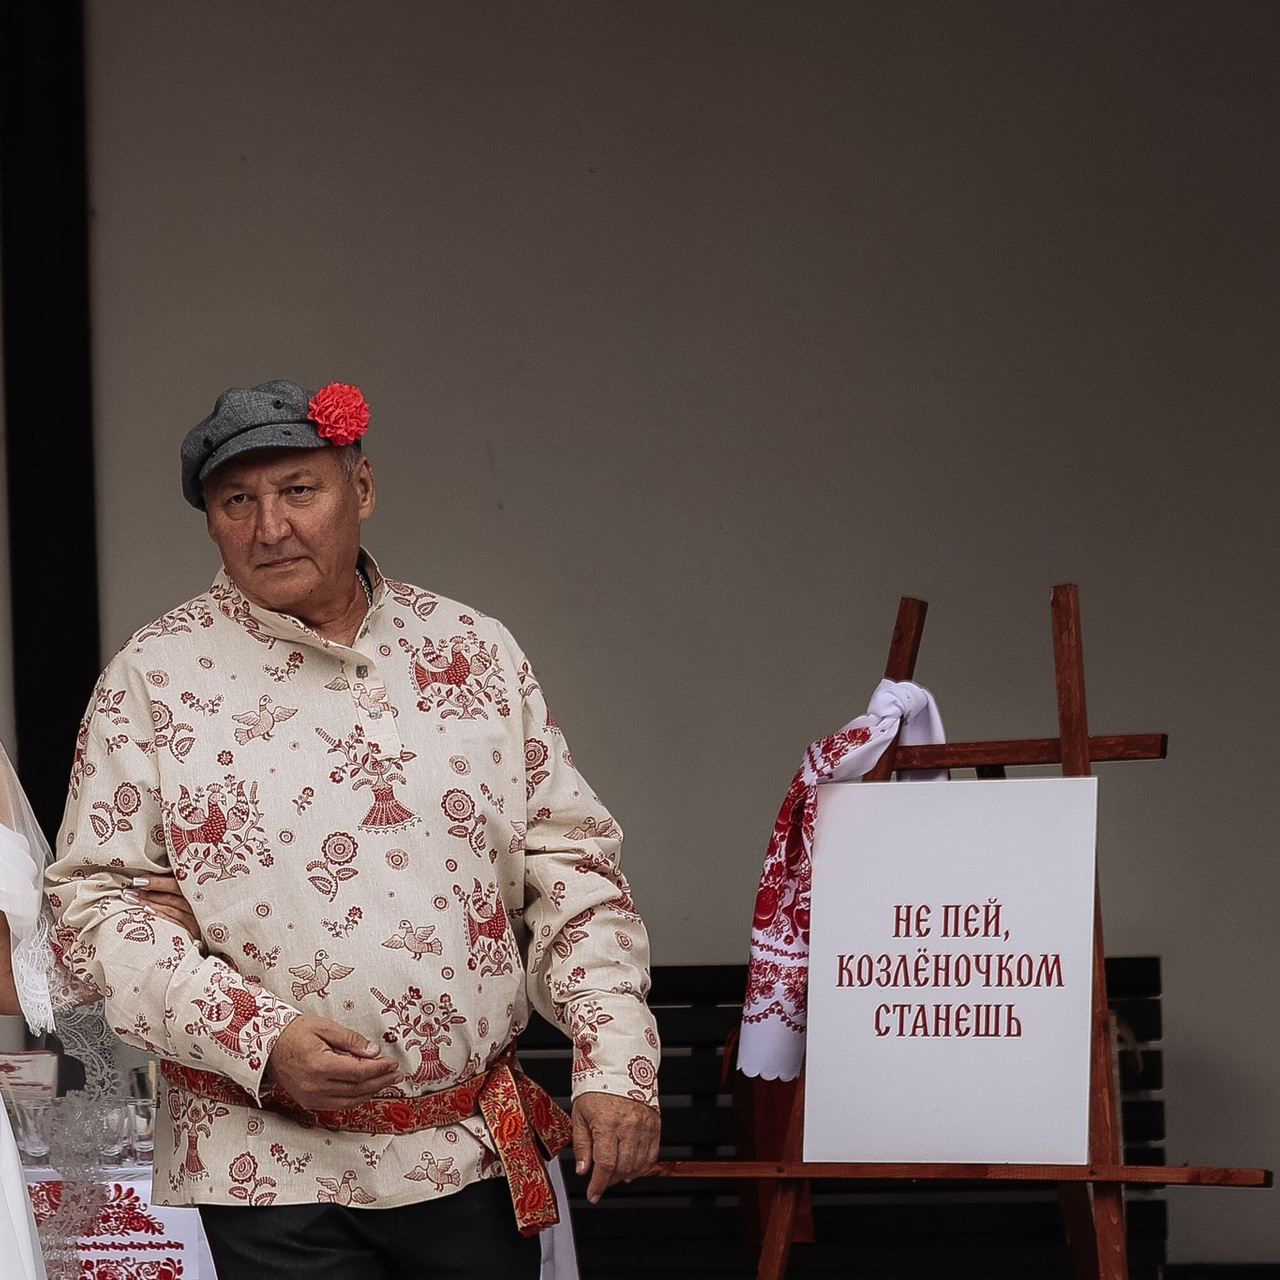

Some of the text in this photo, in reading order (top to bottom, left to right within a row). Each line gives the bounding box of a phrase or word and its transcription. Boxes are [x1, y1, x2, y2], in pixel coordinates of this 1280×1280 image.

[892, 897, 1010, 942] НЕ ПЕЙ,
[835, 947, 1065, 988] КОЗЛЁНОЧКОМ
[874, 1003, 1022, 1037] СТАНЕШЬ
